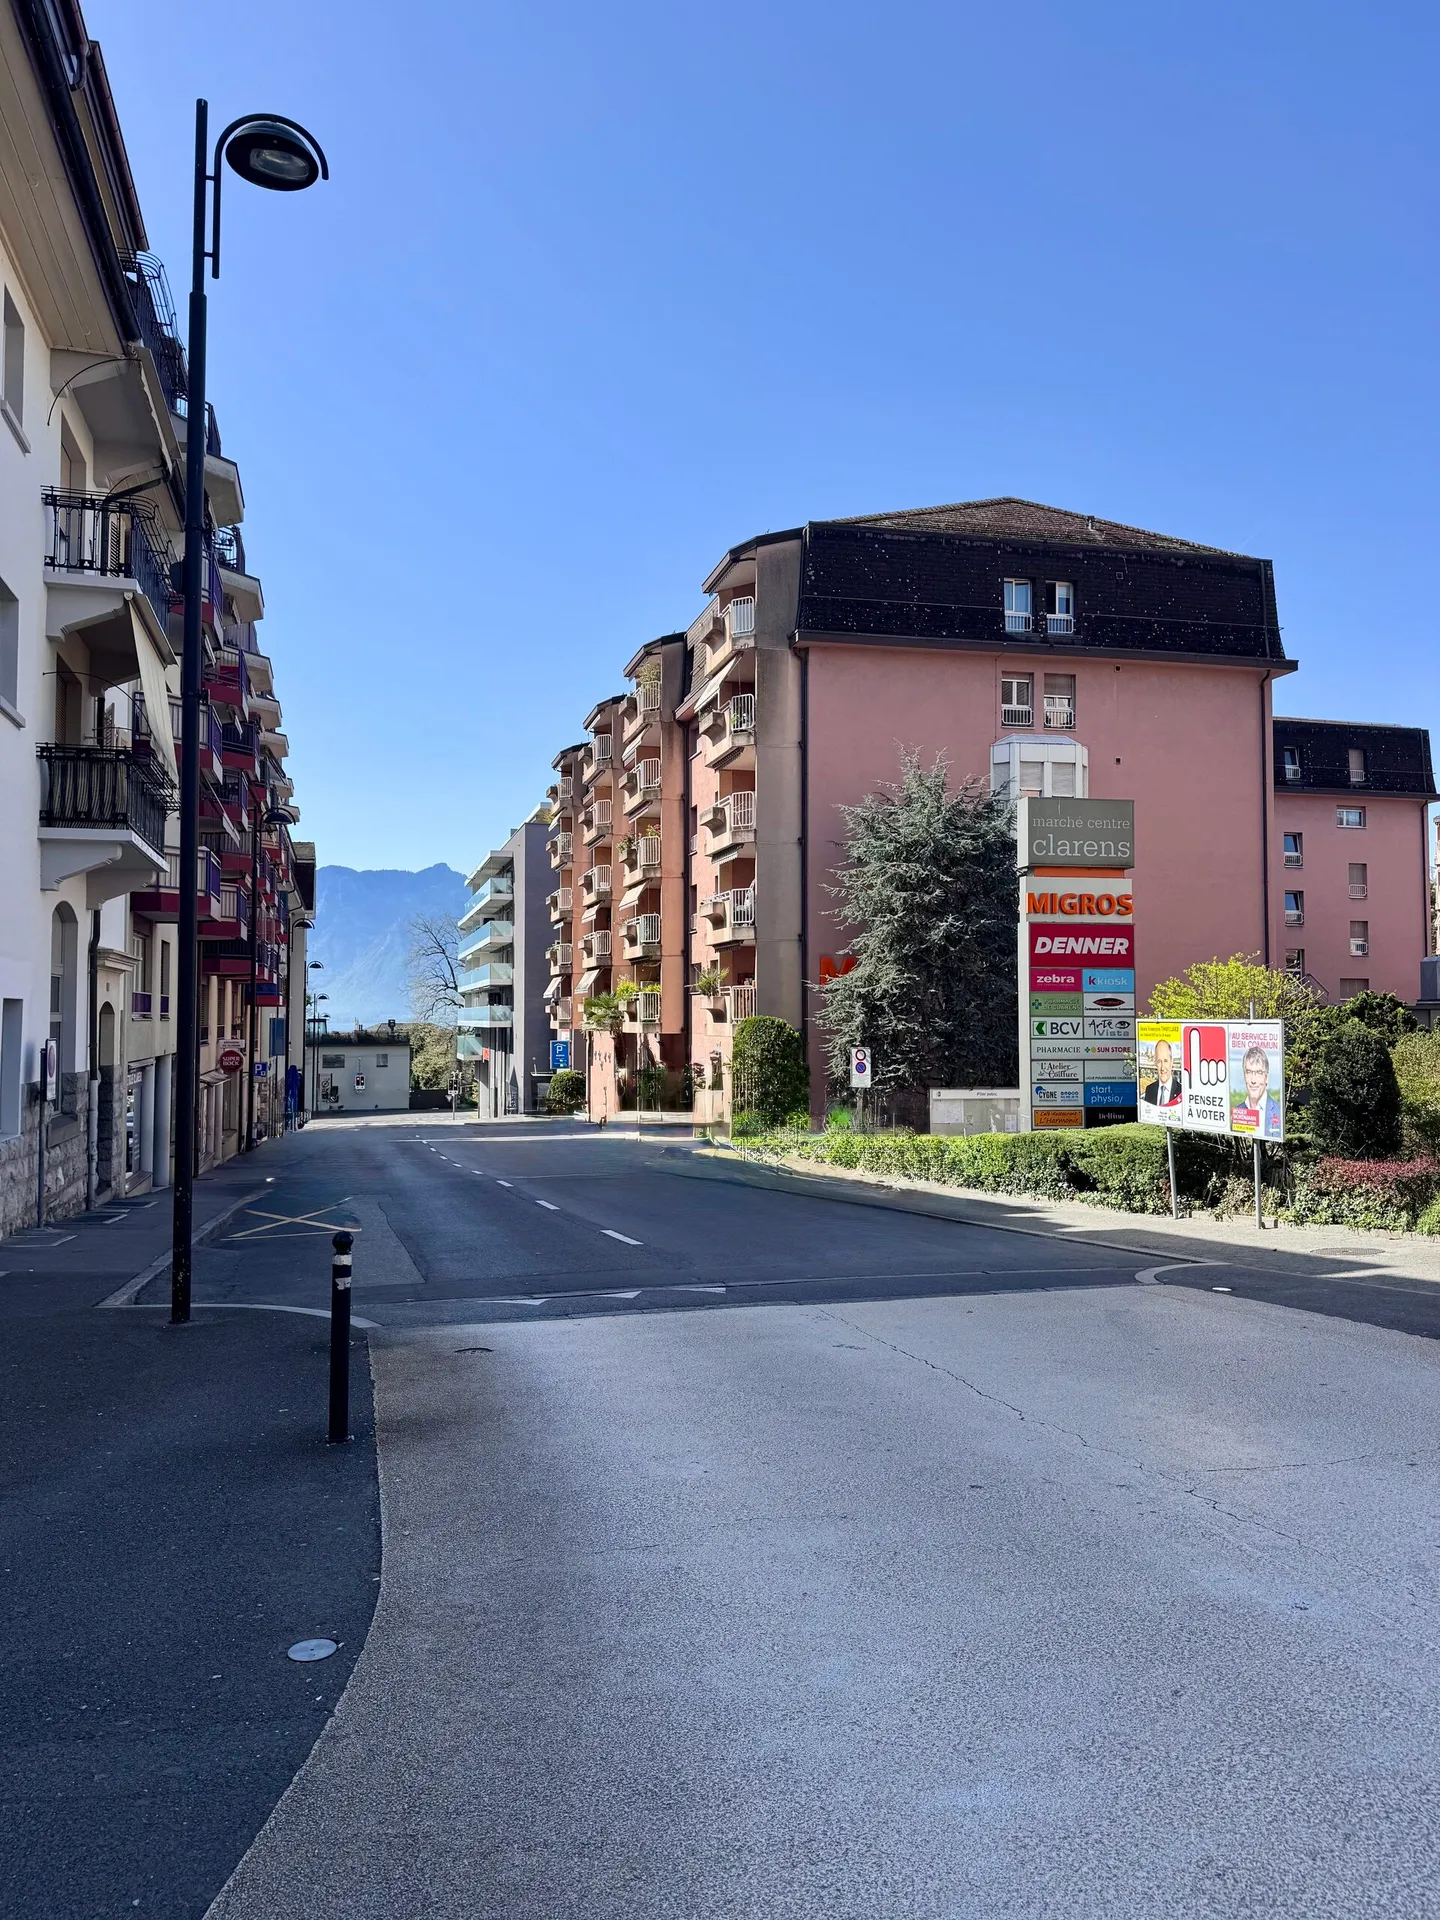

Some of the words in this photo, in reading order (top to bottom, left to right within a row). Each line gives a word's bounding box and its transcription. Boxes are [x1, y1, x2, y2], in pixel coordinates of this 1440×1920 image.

[1032, 815, 1083, 828] marché
[1087, 818, 1130, 829] centre
[1032, 834, 1130, 858] clarens
[1027, 892, 1134, 916] MIGROS
[1034, 936, 1129, 955] DENNER
[1036, 974, 1075, 983] zebra
[1050, 1022, 1081, 1035] BCV
[1096, 1029, 1130, 1037] Vista
[1231, 1032, 1240, 1040] AU
[1241, 1032, 1268, 1041] SERVICE
[1269, 1033, 1278, 1041] DU
[1231, 1040, 1246, 1048] BIEN
[1247, 1040, 1278, 1049] COMMUN
[254, 1063, 262, 1074] P
[1038, 1091, 1057, 1099] CYGNE
[1091, 1085, 1113, 1094] start.
[1188, 1094, 1224, 1107] PENSEZ
[1187, 1105, 1193, 1118] À
[1196, 1110, 1225, 1122] VOTER
